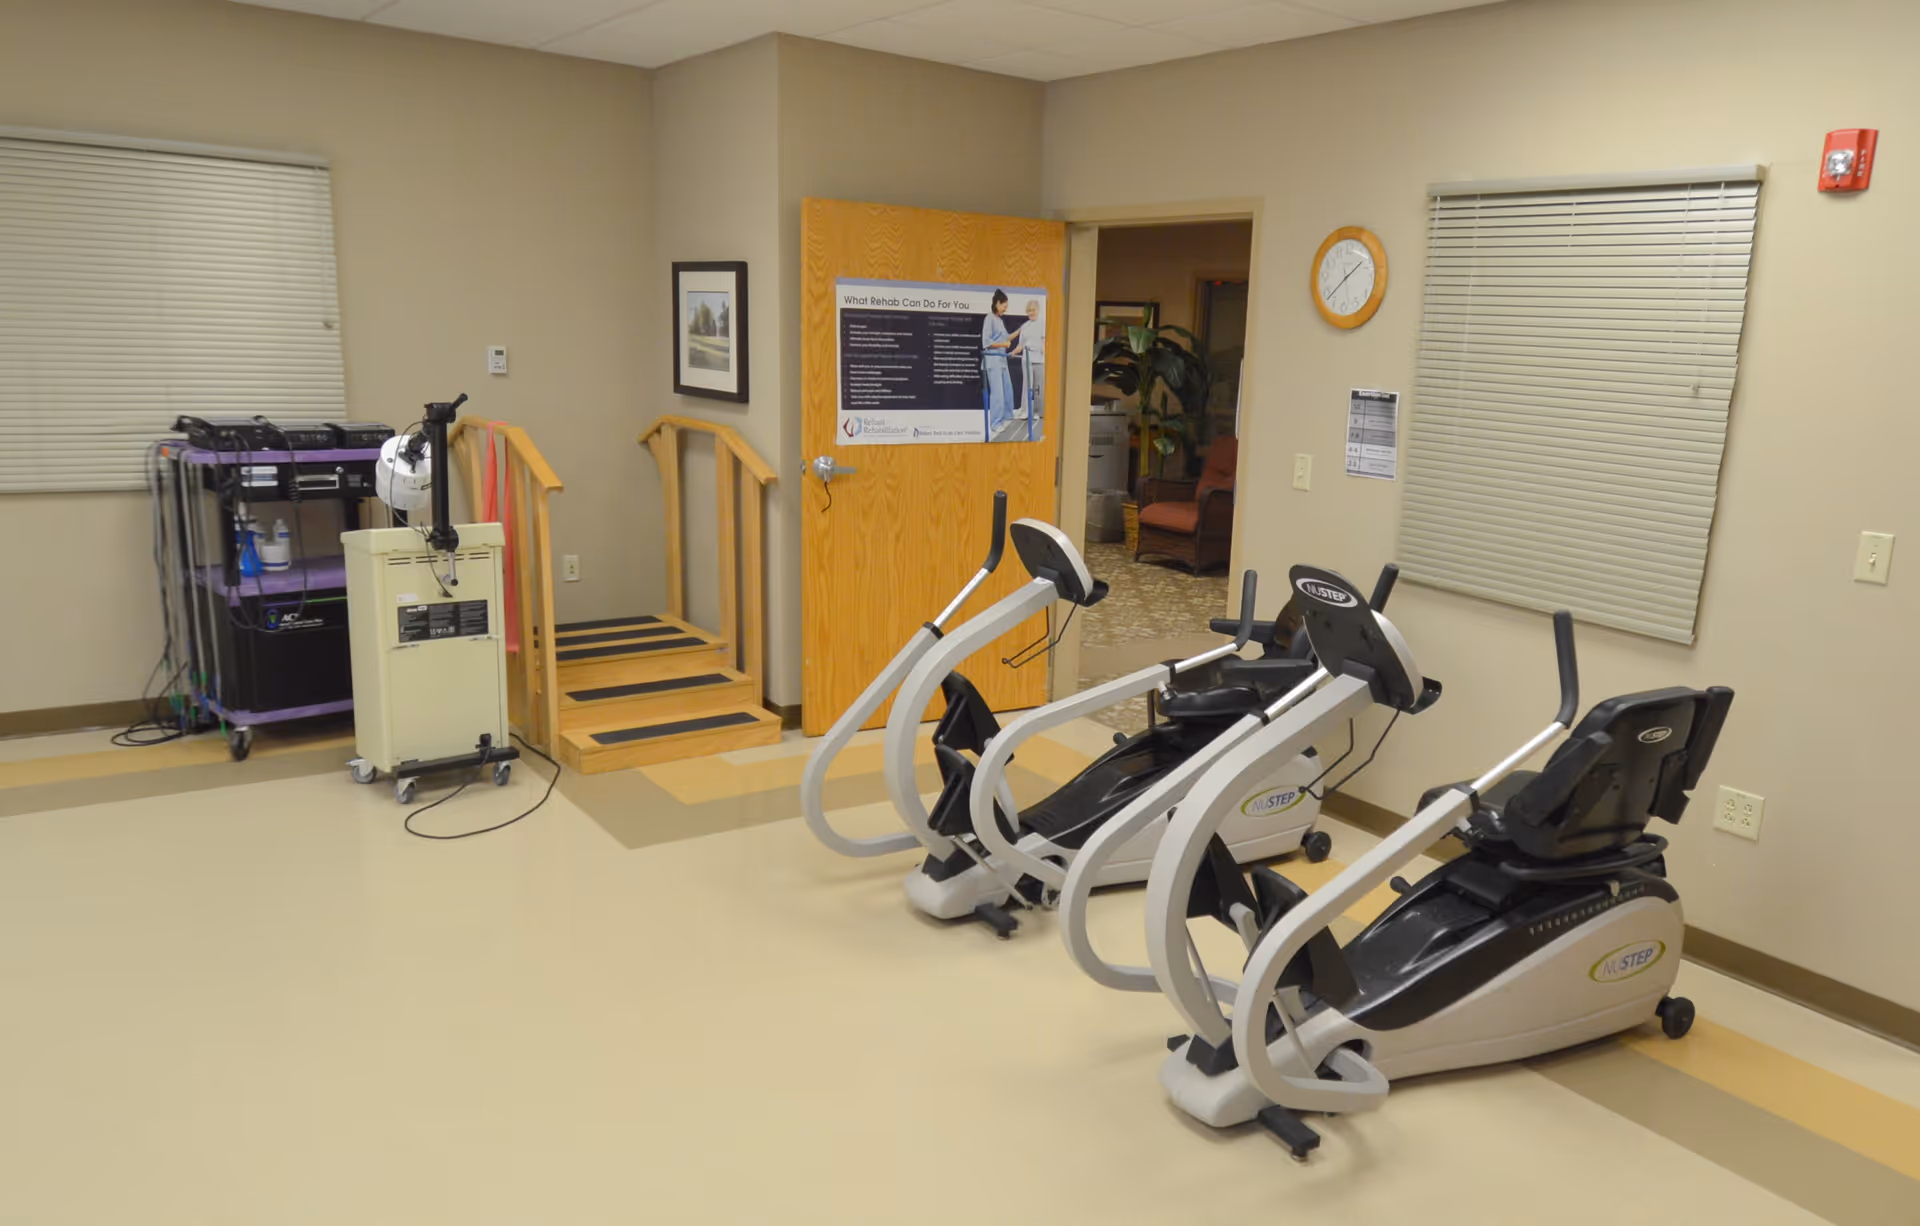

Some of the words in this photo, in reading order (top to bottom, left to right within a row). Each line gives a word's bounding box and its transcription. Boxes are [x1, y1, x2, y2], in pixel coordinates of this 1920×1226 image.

[844, 295, 868, 305] What
[870, 296, 900, 306] Rehab
[902, 298, 921, 308] Can
[923, 299, 936, 308] Do
[937, 300, 951, 309] For
[953, 301, 970, 310] You
[1306, 583, 1346, 602] NUSTEP
[1252, 791, 1296, 812] NUSTEP
[1602, 947, 1654, 977] NUSTEP
